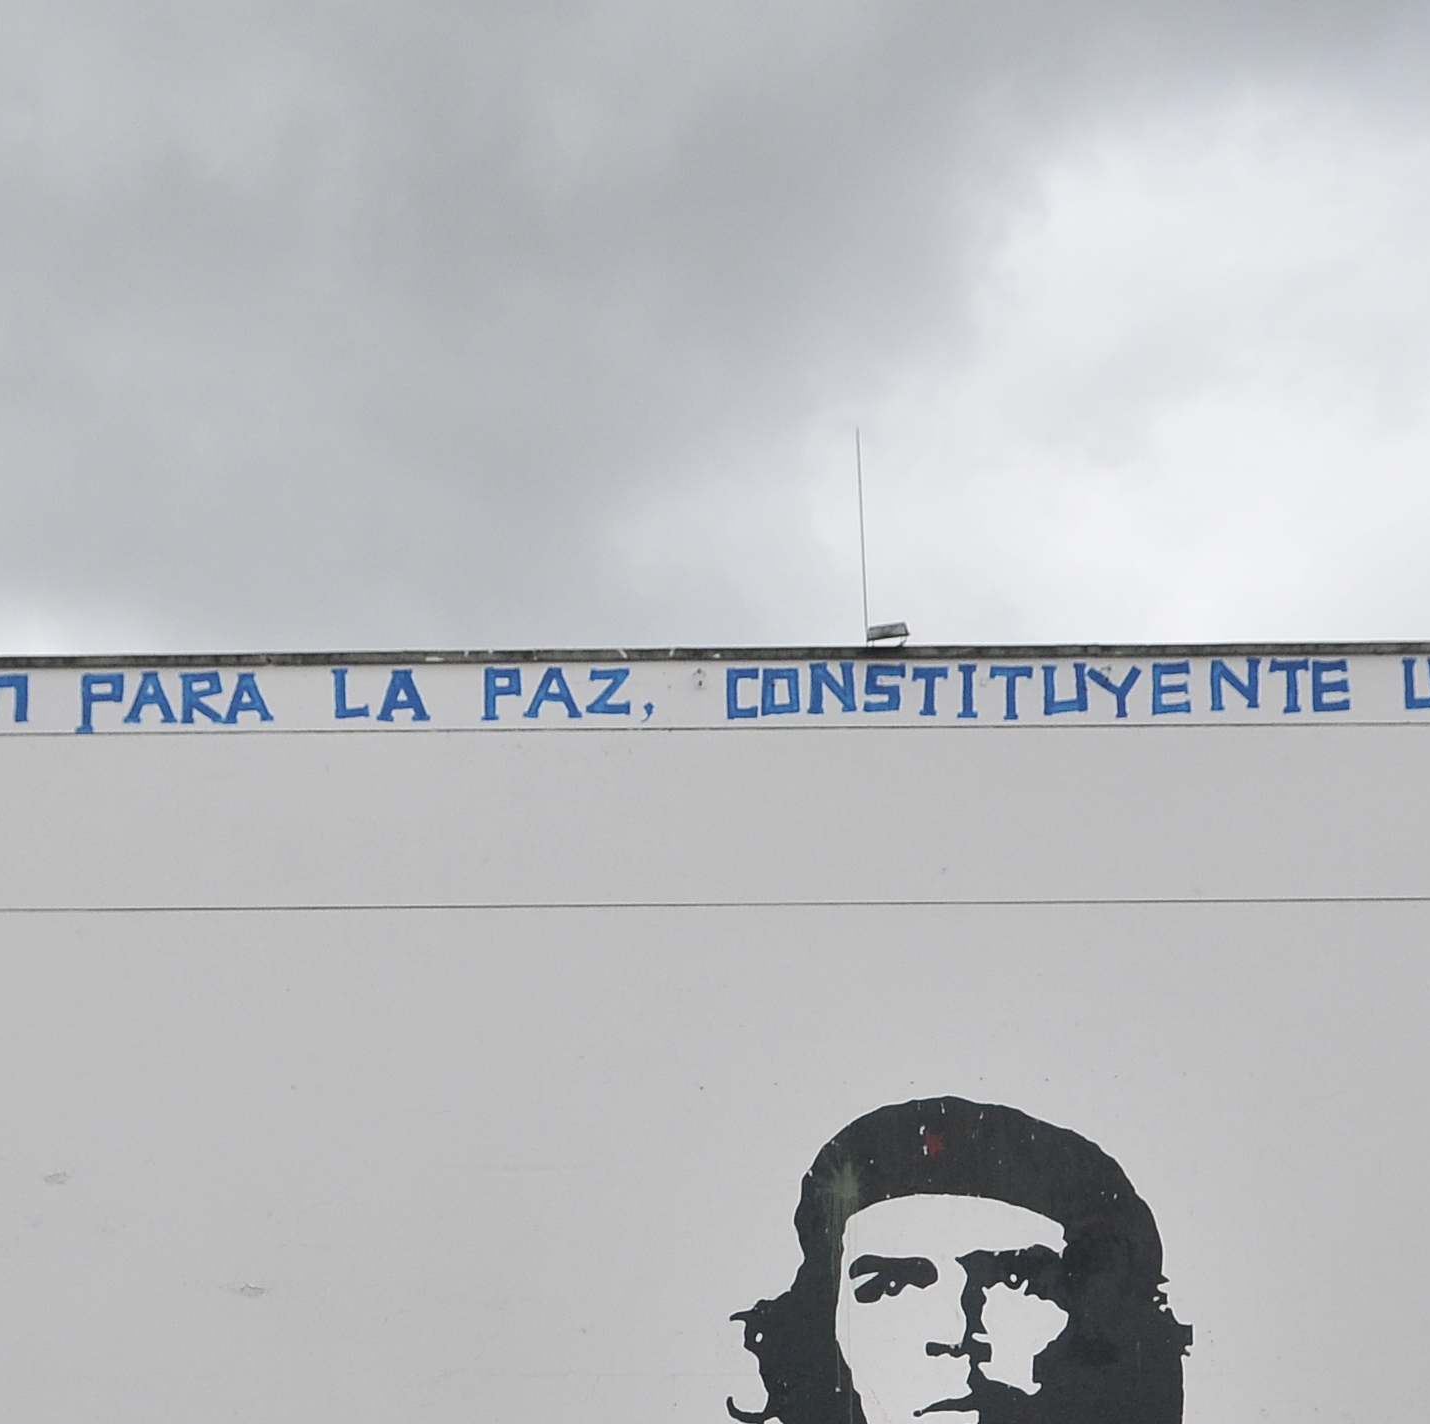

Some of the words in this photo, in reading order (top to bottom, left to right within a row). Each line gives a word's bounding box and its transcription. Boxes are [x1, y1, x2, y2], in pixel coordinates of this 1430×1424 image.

[75, 670, 274, 734] PARA
[331, 668, 431, 722] LA
[482, 667, 657, 723] PAZ,
[726, 656, 1351, 722] CONSTITUYENTE
